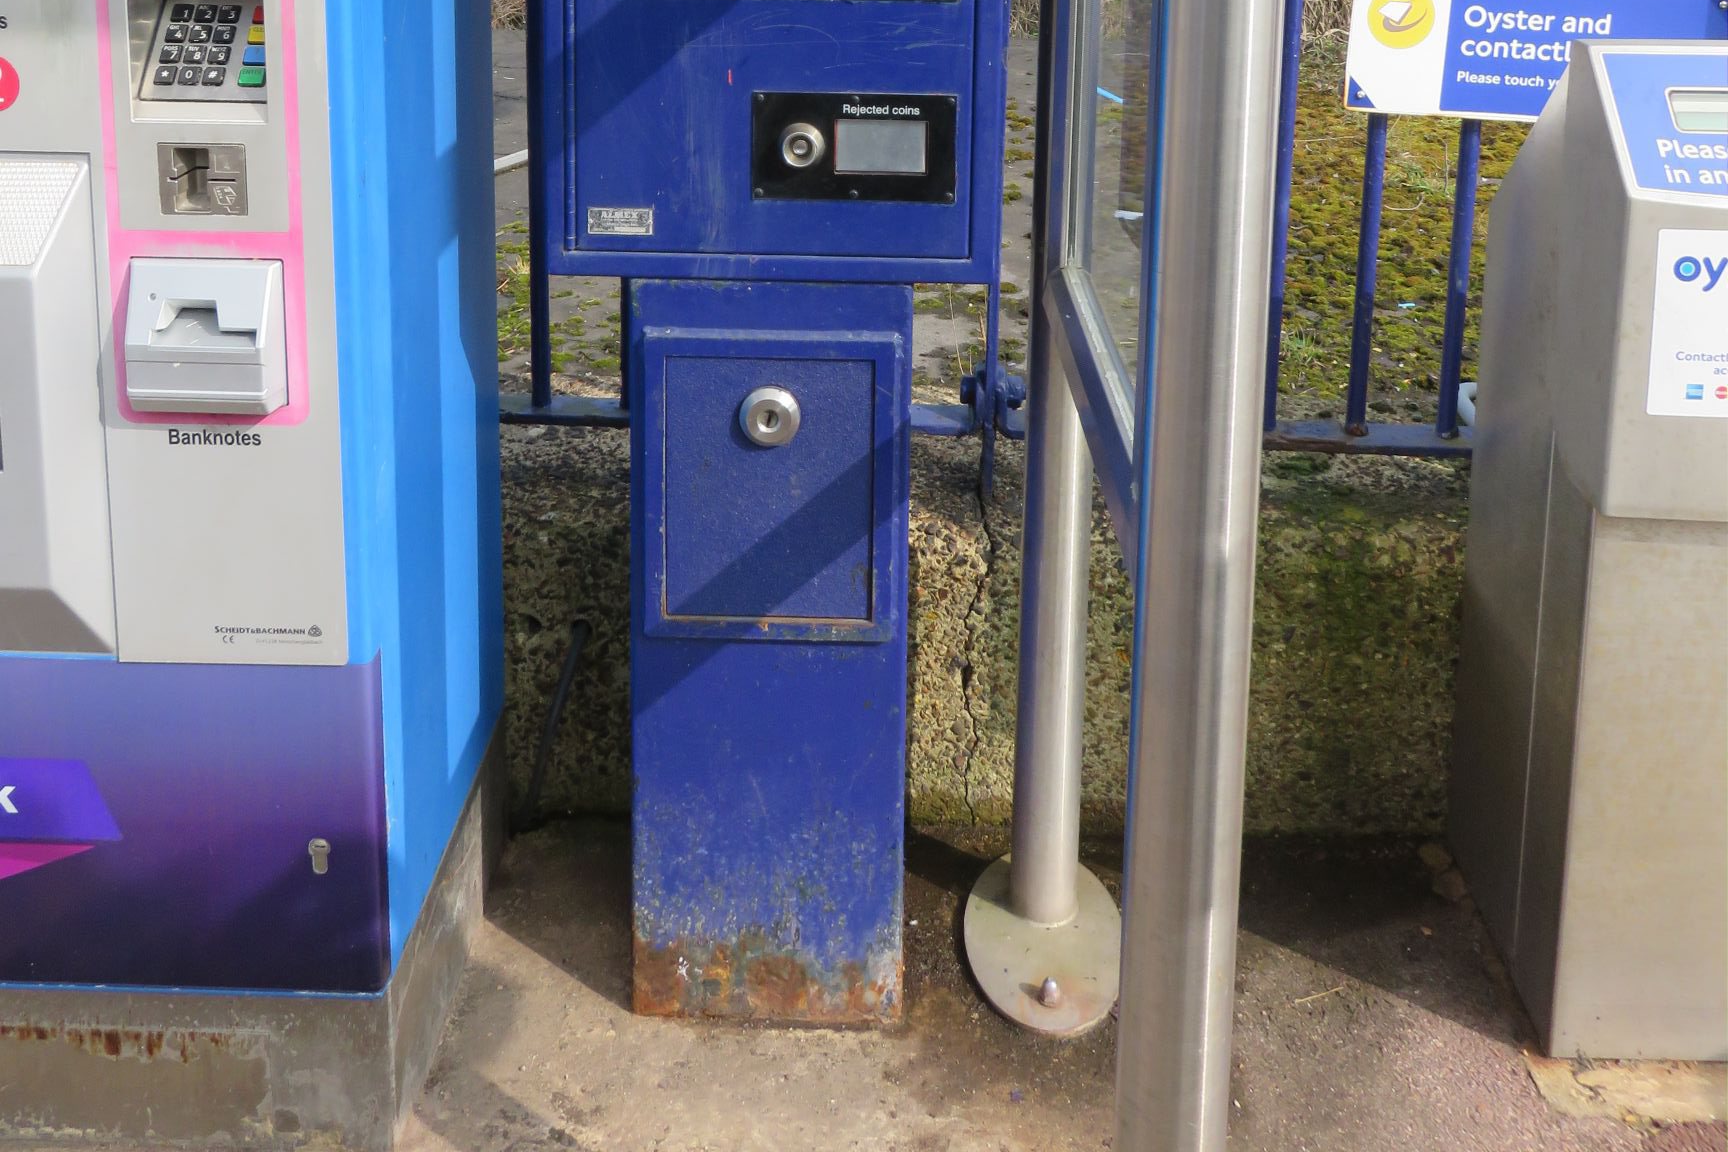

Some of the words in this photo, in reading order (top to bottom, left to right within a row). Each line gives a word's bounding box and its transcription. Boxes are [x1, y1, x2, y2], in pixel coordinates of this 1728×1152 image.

[183, 9, 189, 19] 1
[204, 10, 212, 19] 2
[228, 10, 235, 20] 3
[1464, 5, 1556, 34] Oyster
[1561, 14, 1611, 35] and
[174, 30, 182, 39] 4
[199, 30, 207, 39] 5
[223, 31, 230, 40] 6
[170, 51, 176, 60] 7
[193, 51, 201, 60] 8
[218, 52, 225, 61] 9
[1456, 70, 1500, 85] Please
[1504, 74, 1544, 87] touch
[842, 103, 889, 117] Rejected
[891, 105, 920, 116] coins
[1656, 139, 1728, 160] Pleas
[1664, 164, 1691, 184] in
[1699, 168, 1728, 185] an
[1673, 256, 1728, 292] oy
[168, 428, 262, 446] Banknotes
